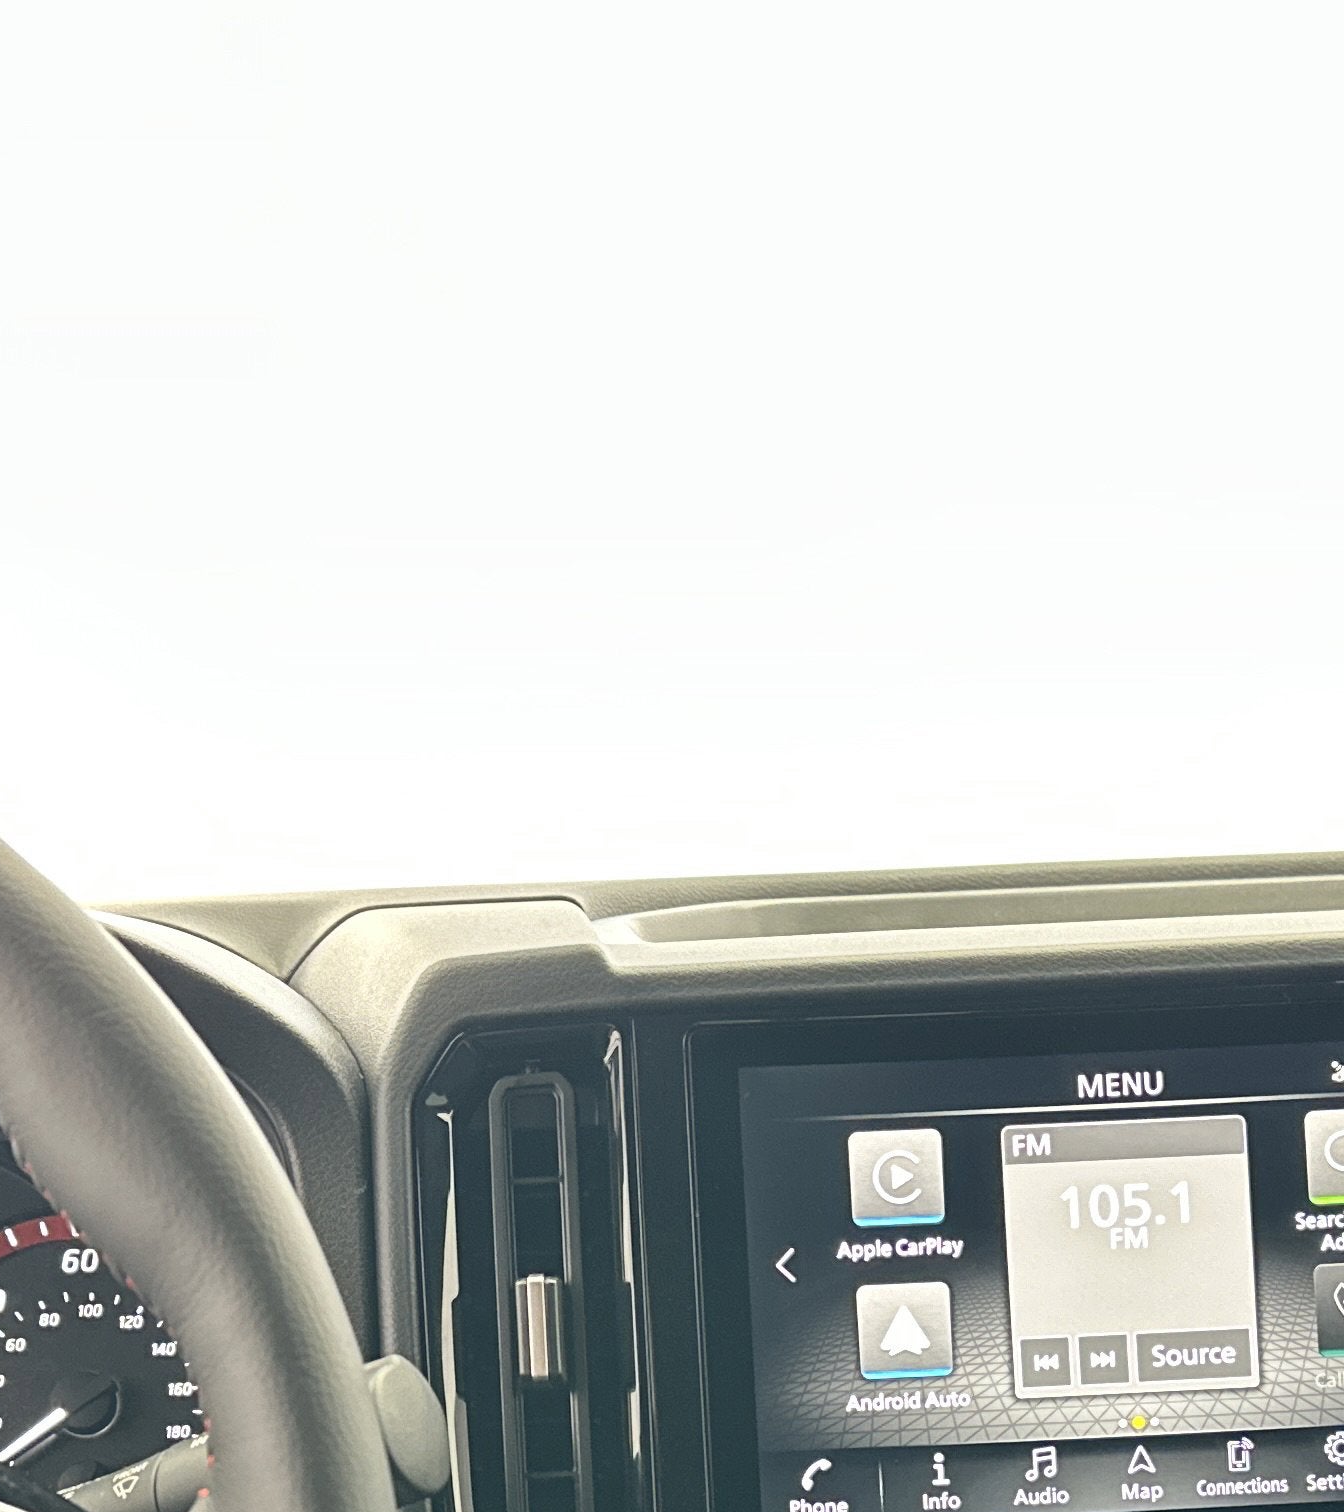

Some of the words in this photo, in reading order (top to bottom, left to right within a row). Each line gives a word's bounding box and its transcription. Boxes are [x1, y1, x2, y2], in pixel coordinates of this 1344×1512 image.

[1077, 1071, 1164, 1098] MENU
[1012, 1133, 1051, 1157] FM
[1059, 1180, 1192, 1229] 105.1
[1109, 1228, 1148, 1250] FM
[836, 1239, 892, 1263] Apple
[895, 1236, 964, 1260] CarPlay
[61, 1248, 99, 1273] 60
[38, 1312, 60, 1327] 80
[78, 1303, 103, 1318] 100
[119, 1315, 144, 1329] 120
[5, 1337, 26, 1352] 60
[151, 1342, 176, 1357] 140
[1151, 1344, 1236, 1367] Source
[168, 1381, 193, 1397] 160
[846, 1392, 922, 1413] Android
[925, 1391, 971, 1409] Auto
[166, 1425, 191, 1439] 180
[1121, 1483, 1164, 1502] Map
[1196, 1476, 1288, 1497] Connections
[922, 1493, 961, 1510] Info
[1014, 1487, 1070, 1506] Audio
